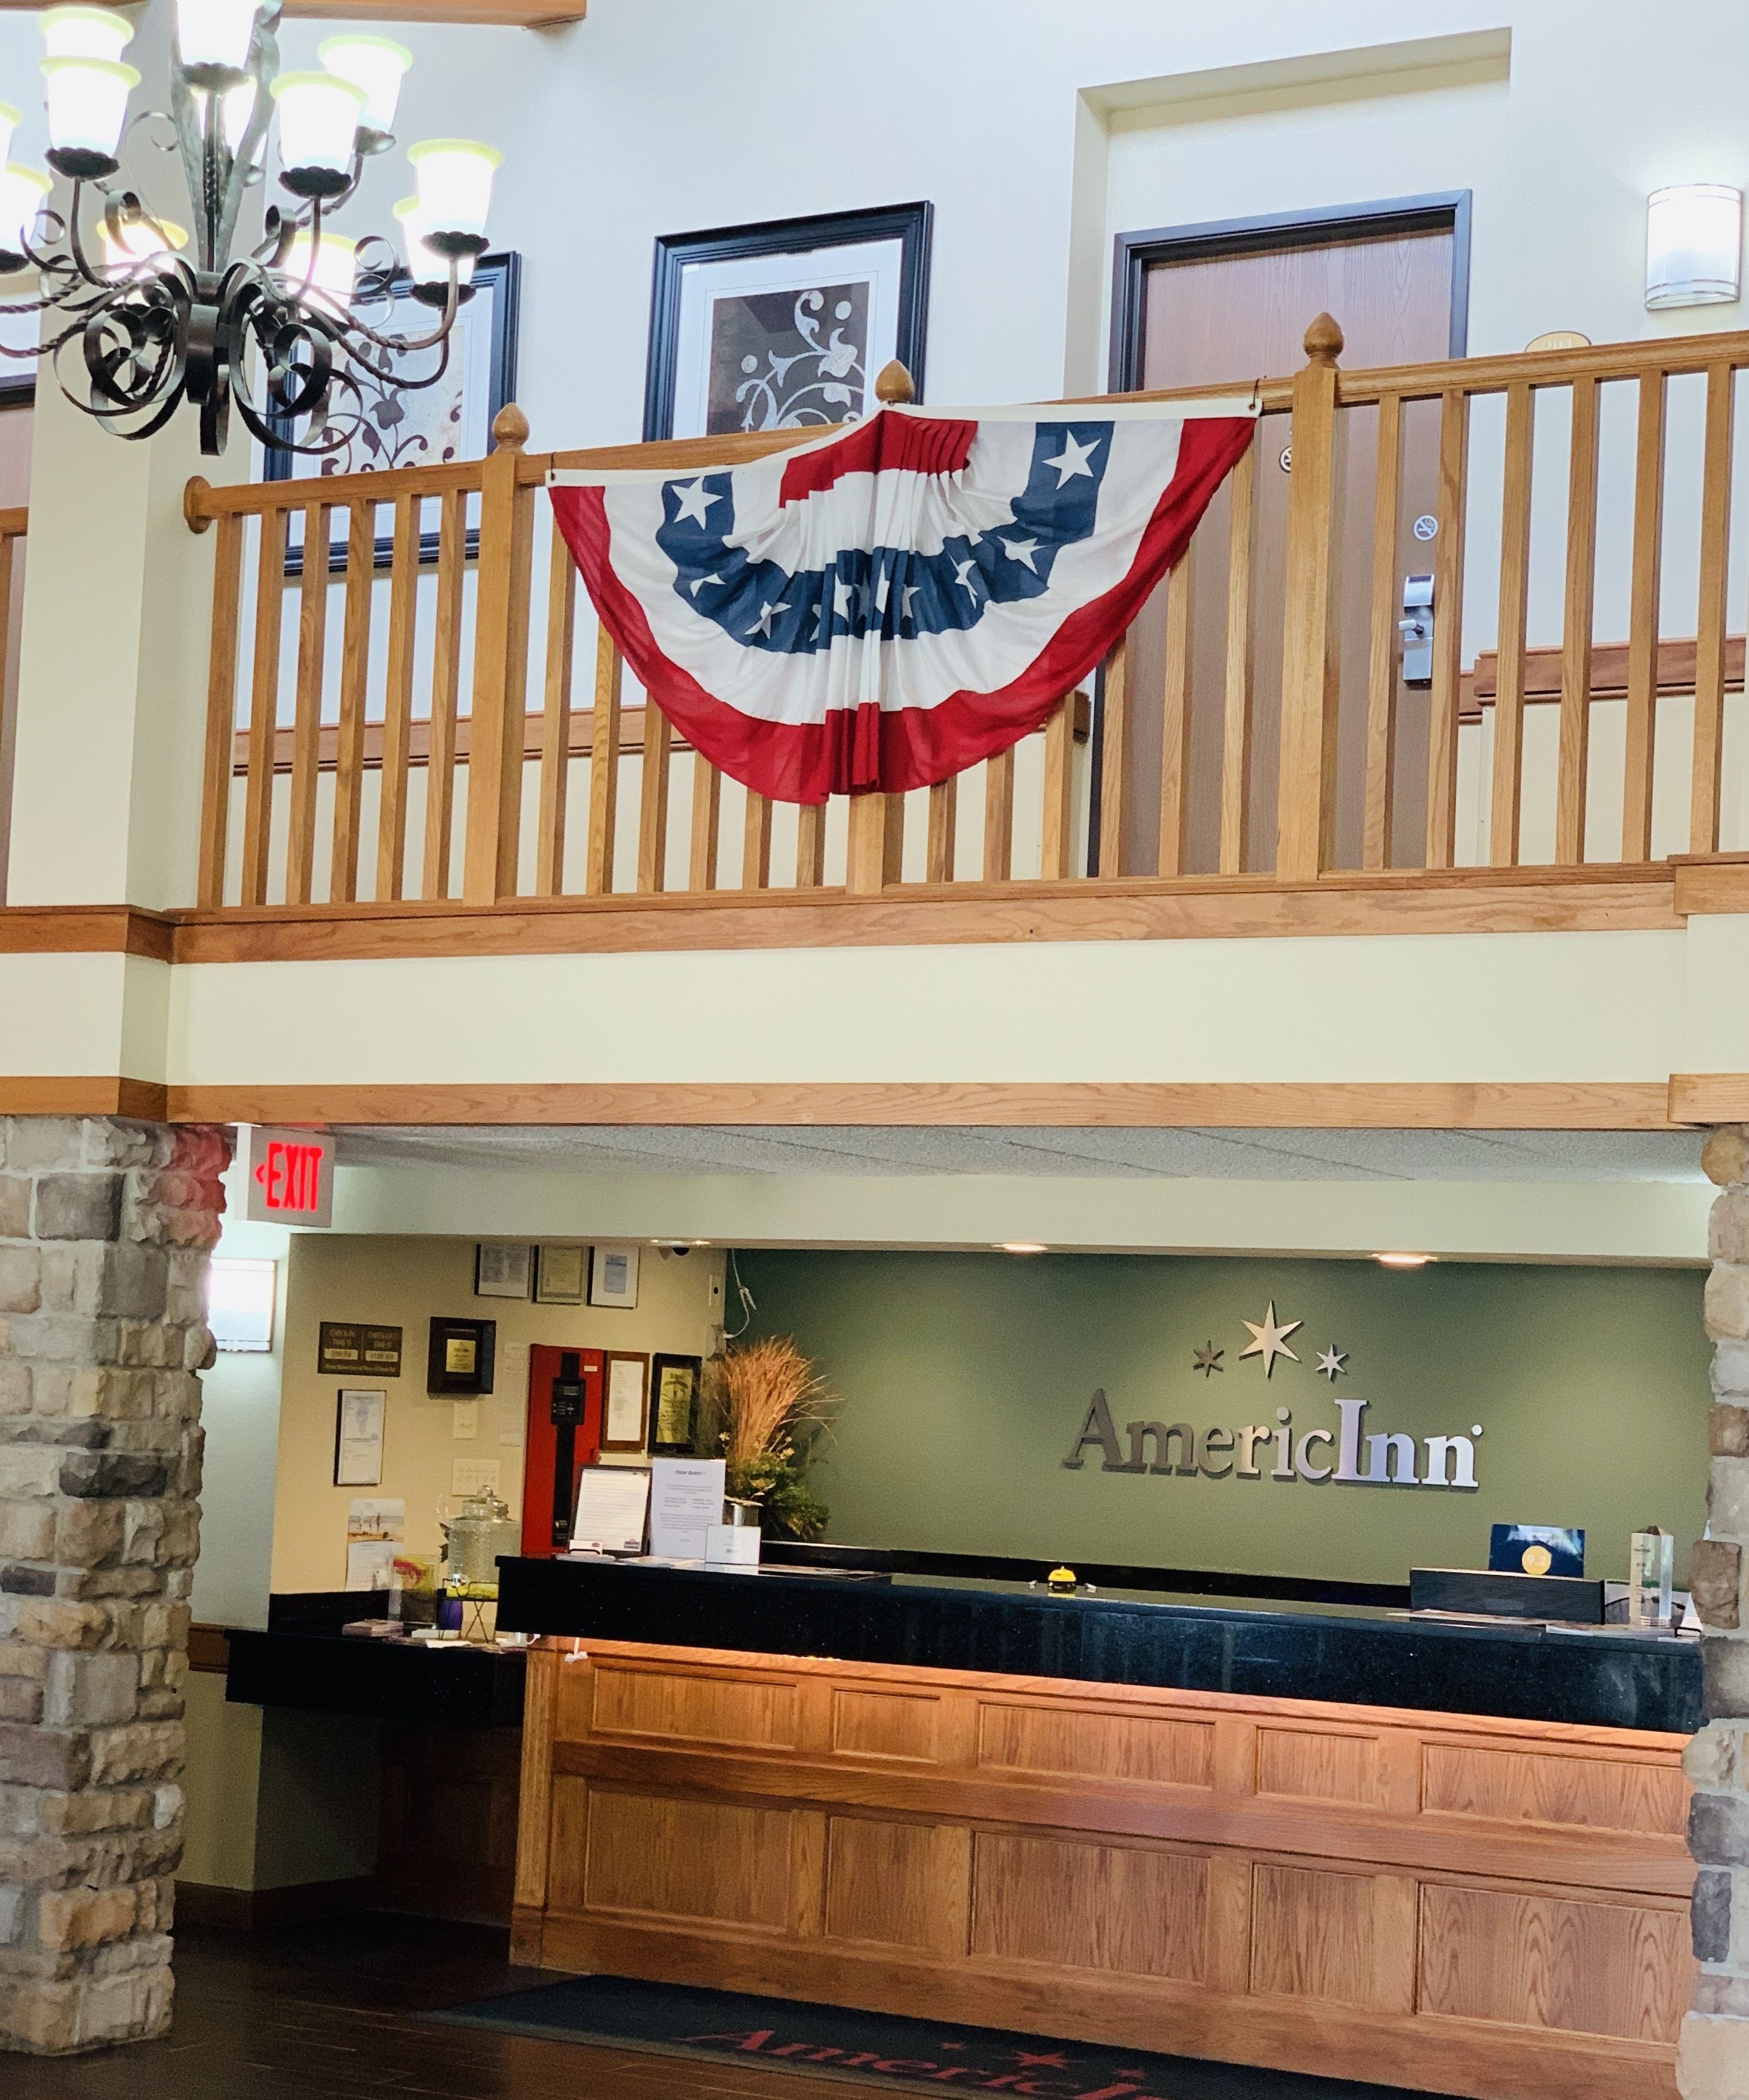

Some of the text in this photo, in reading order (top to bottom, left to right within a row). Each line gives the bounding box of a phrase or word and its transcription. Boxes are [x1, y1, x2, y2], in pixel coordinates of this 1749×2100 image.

[266, 1142, 323, 1212] EXIT
[1062, 1387, 1479, 1492] AmericInn
[1526, 1554, 1546, 1567] 9.2
